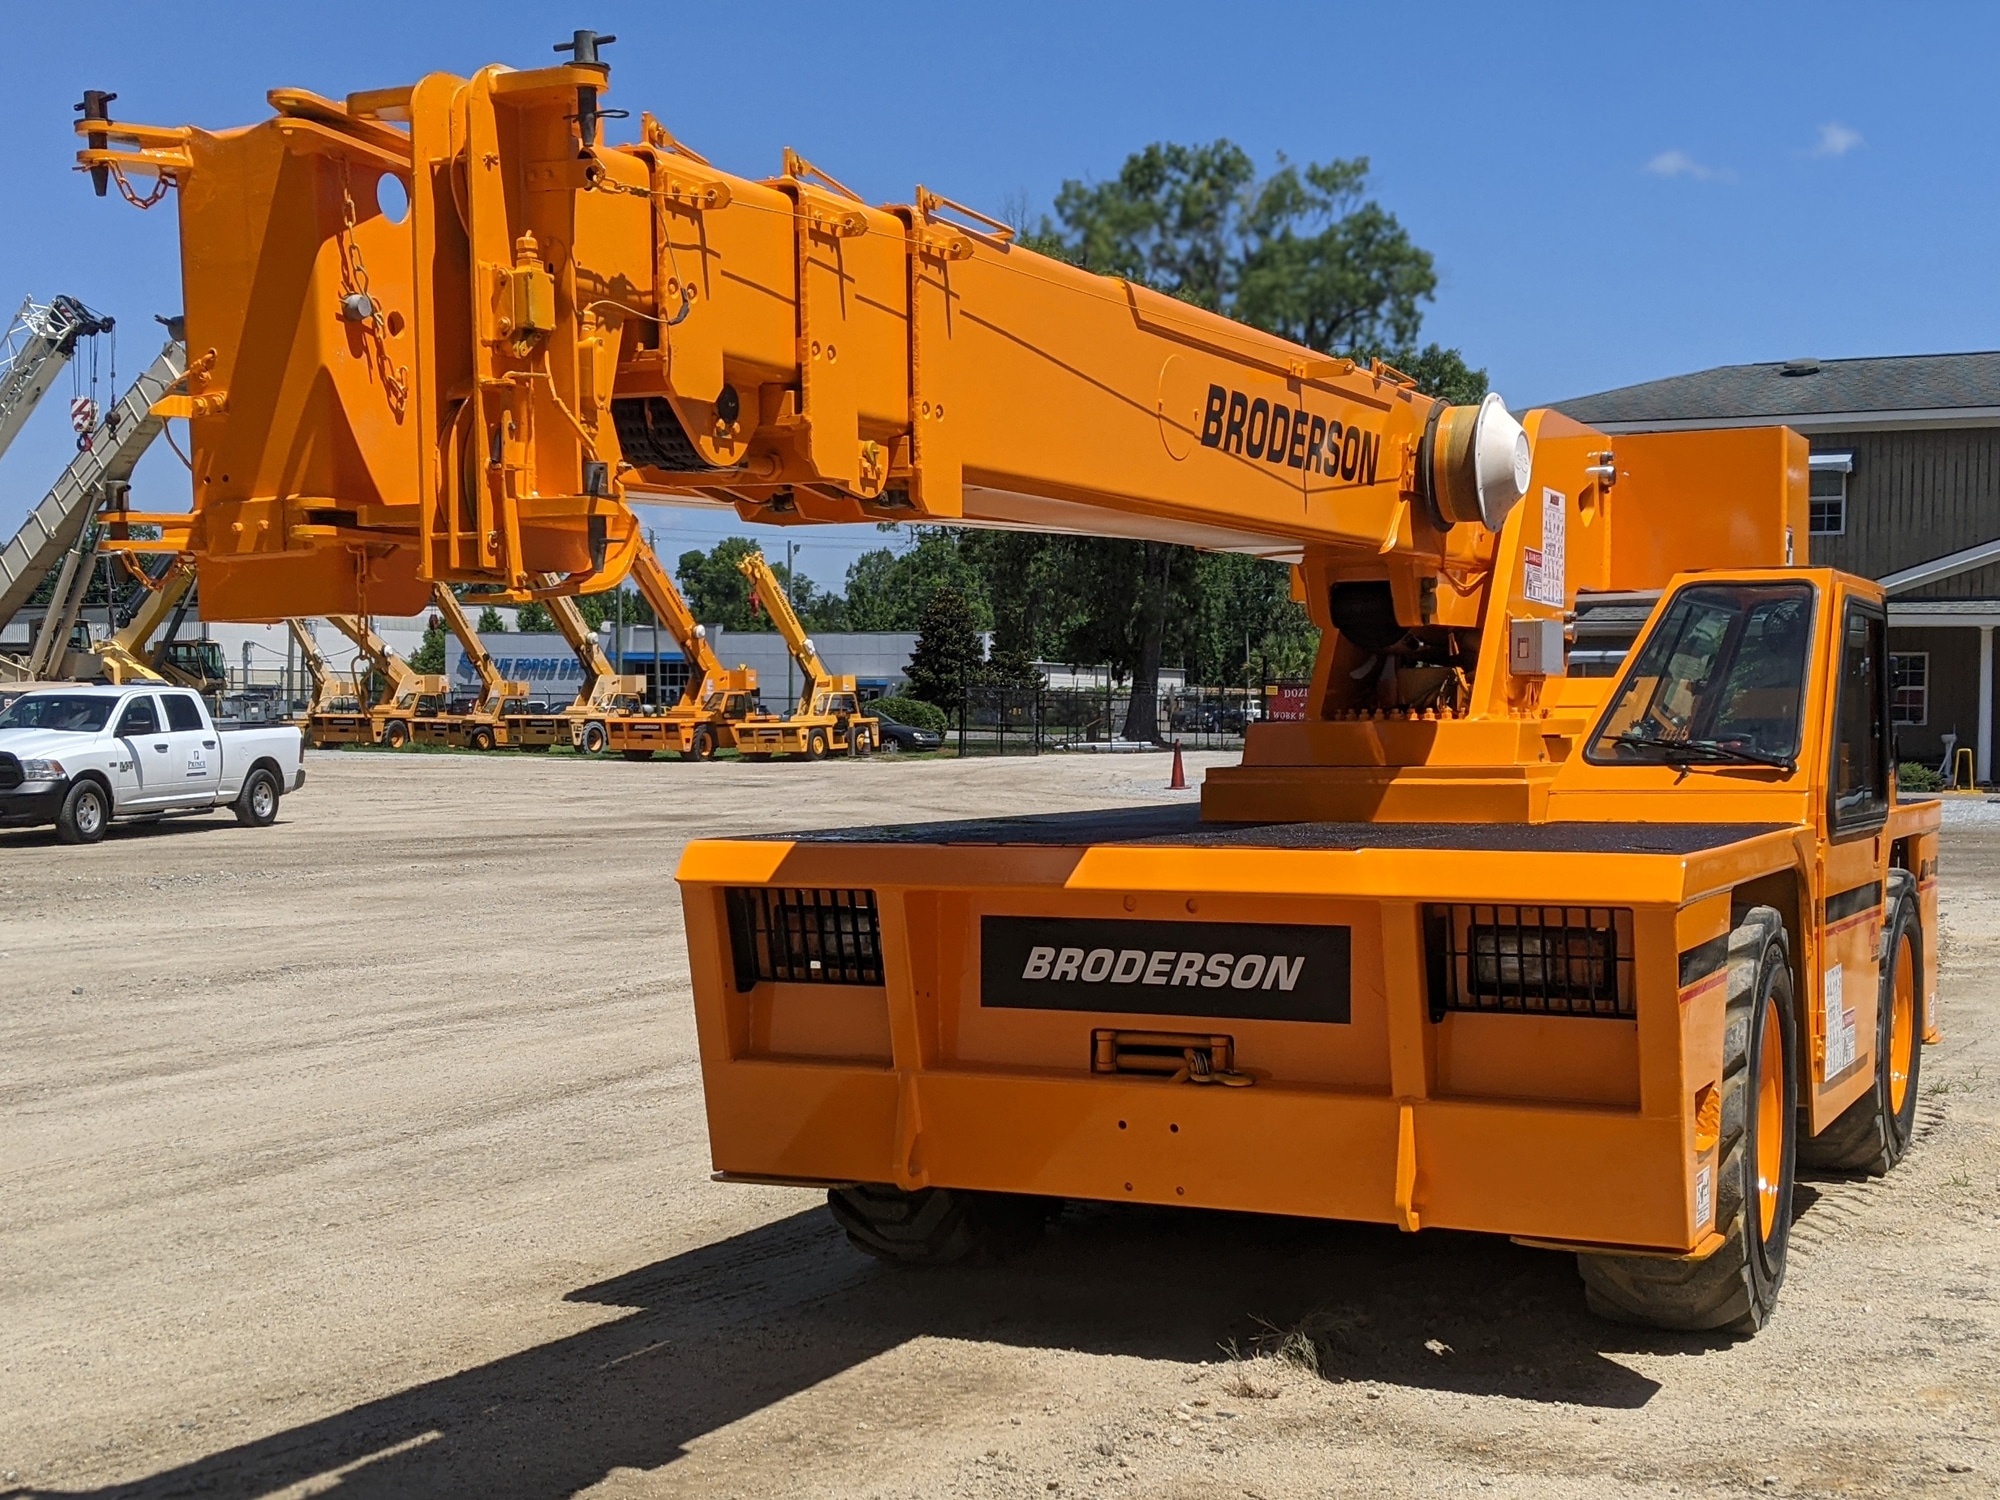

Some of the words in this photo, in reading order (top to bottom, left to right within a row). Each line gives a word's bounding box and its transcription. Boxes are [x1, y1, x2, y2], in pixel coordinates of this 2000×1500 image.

[1201, 383, 1381, 486] BRODERSON
[1284, 688, 1308, 698] DOZI
[1022, 946, 1305, 991] BRODERSON
